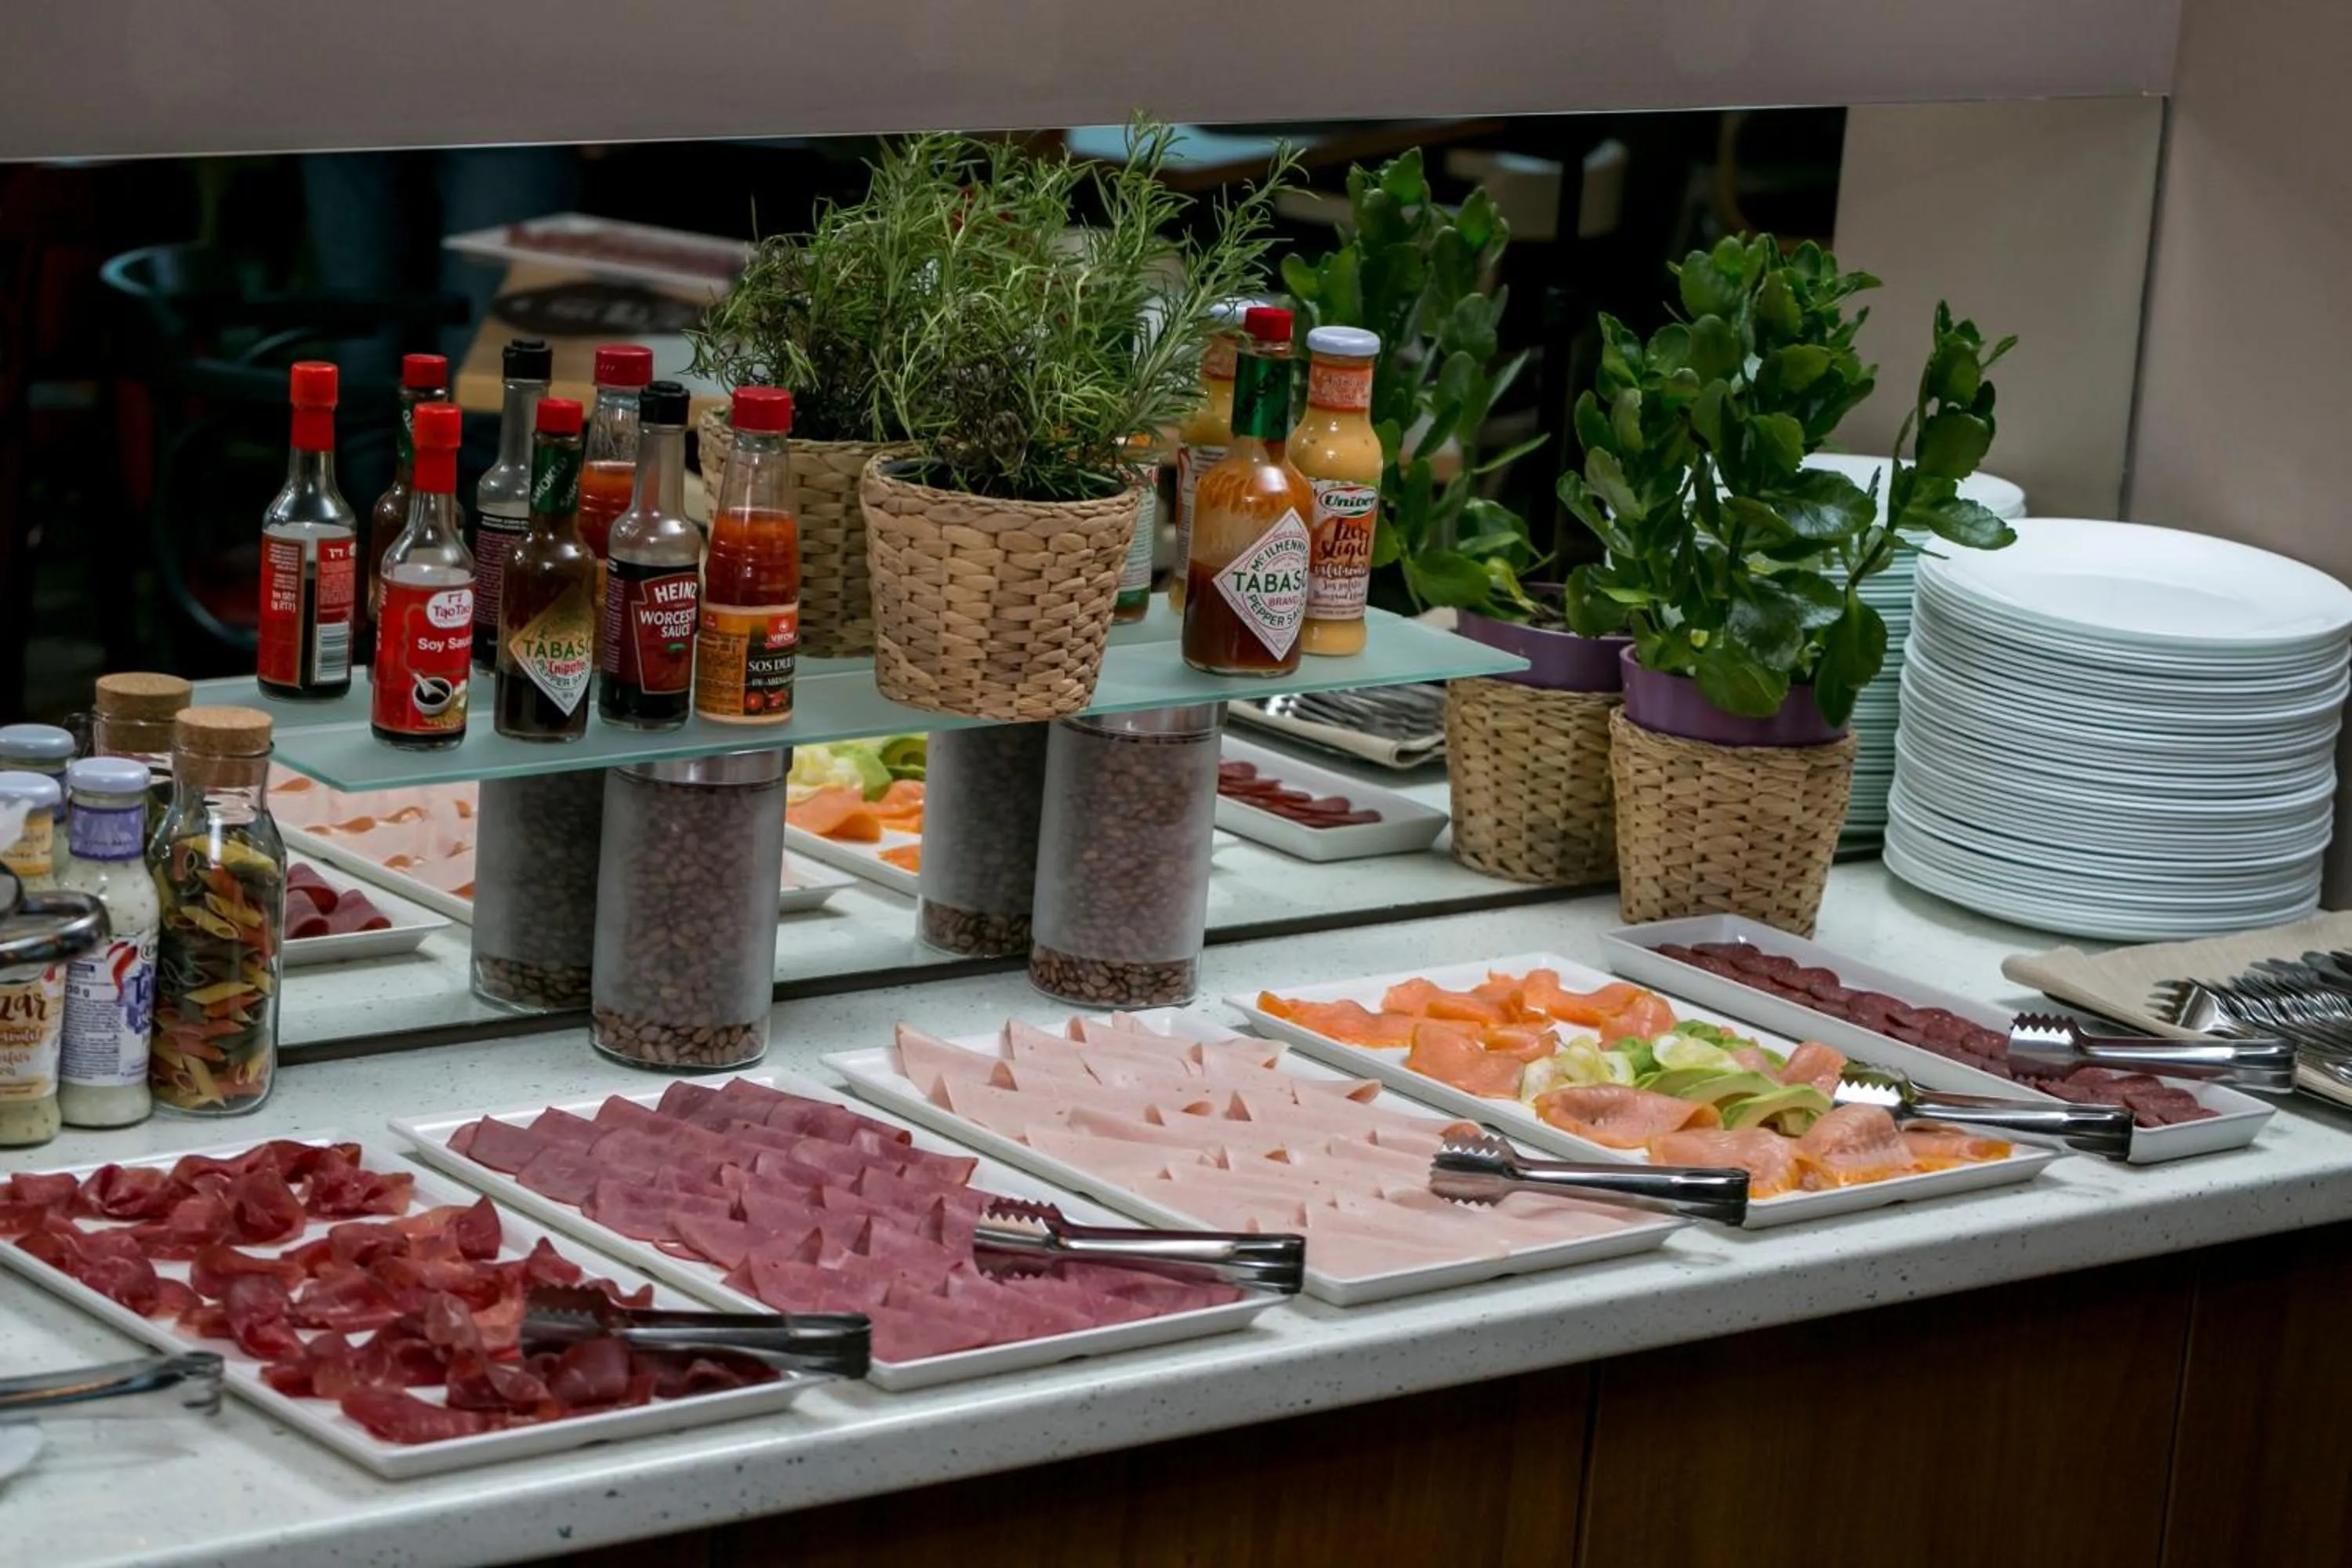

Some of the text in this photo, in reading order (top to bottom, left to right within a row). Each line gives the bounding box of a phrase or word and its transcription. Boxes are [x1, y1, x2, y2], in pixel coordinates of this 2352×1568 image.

[654, 581, 697, 603] HEINZ
[417, 637, 445, 653] Soy
[748, 658, 772, 672] SOS
[0, 985, 48, 1021] zár
